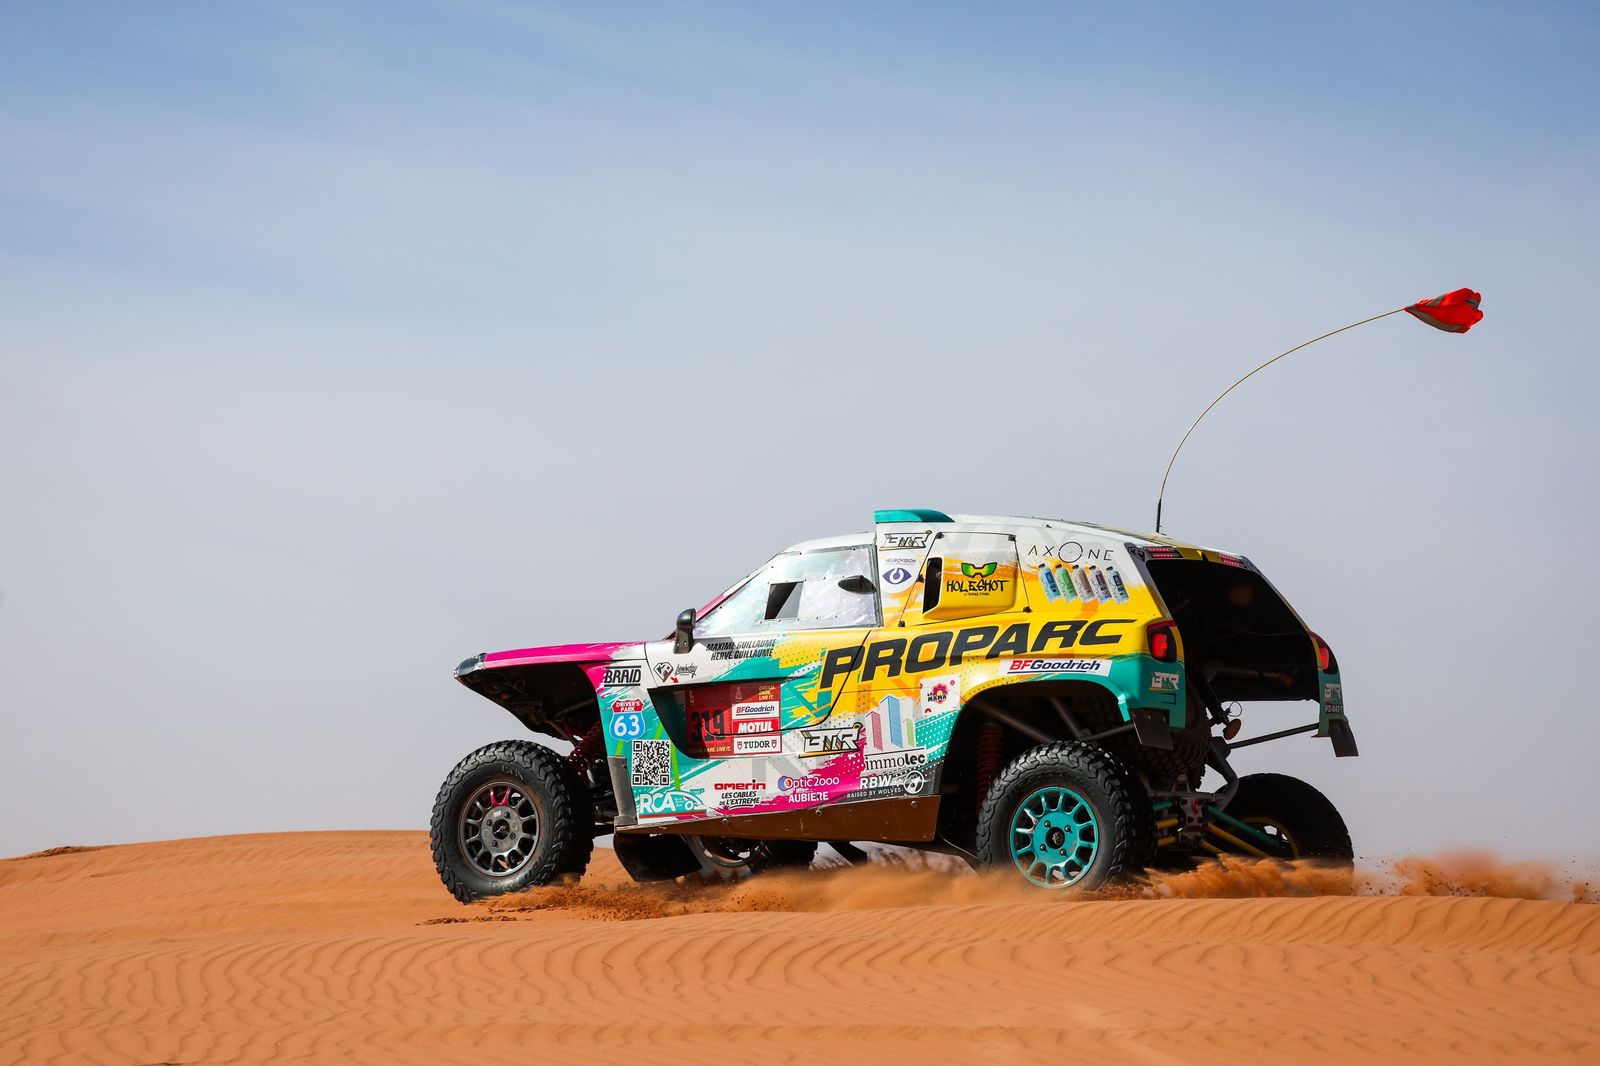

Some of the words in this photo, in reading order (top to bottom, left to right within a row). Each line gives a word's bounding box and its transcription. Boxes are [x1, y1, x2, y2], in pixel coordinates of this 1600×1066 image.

[1028, 541, 1114, 563] AXONE
[946, 579, 1010, 592] HOLESHOT
[706, 642, 735, 651] MAXIME
[736, 639, 777, 649] GUILLAUME
[734, 648, 773, 659] GUILLAUME
[819, 618, 1138, 690] PROPARC
[1009, 659, 1101, 671] BFGoodrich
[604, 668, 641, 684] BRAID
[736, 705, 775, 713] BFGoodrich
[614, 714, 640, 737] 63
[691, 709, 725, 741] 319
[738, 721, 773, 734] MOTUL
[744, 740, 770, 749] TUDOR
[865, 753, 926, 770] immolec
[714, 779, 766, 790] omerin
[784, 777, 812, 791] Optic
[813, 776, 840, 787] 2000
[860, 775, 892, 790] RBW
[846, 790, 868, 798] RAISED
[877, 786, 902, 795] WOLVES
[639, 791, 677, 813] RCA
